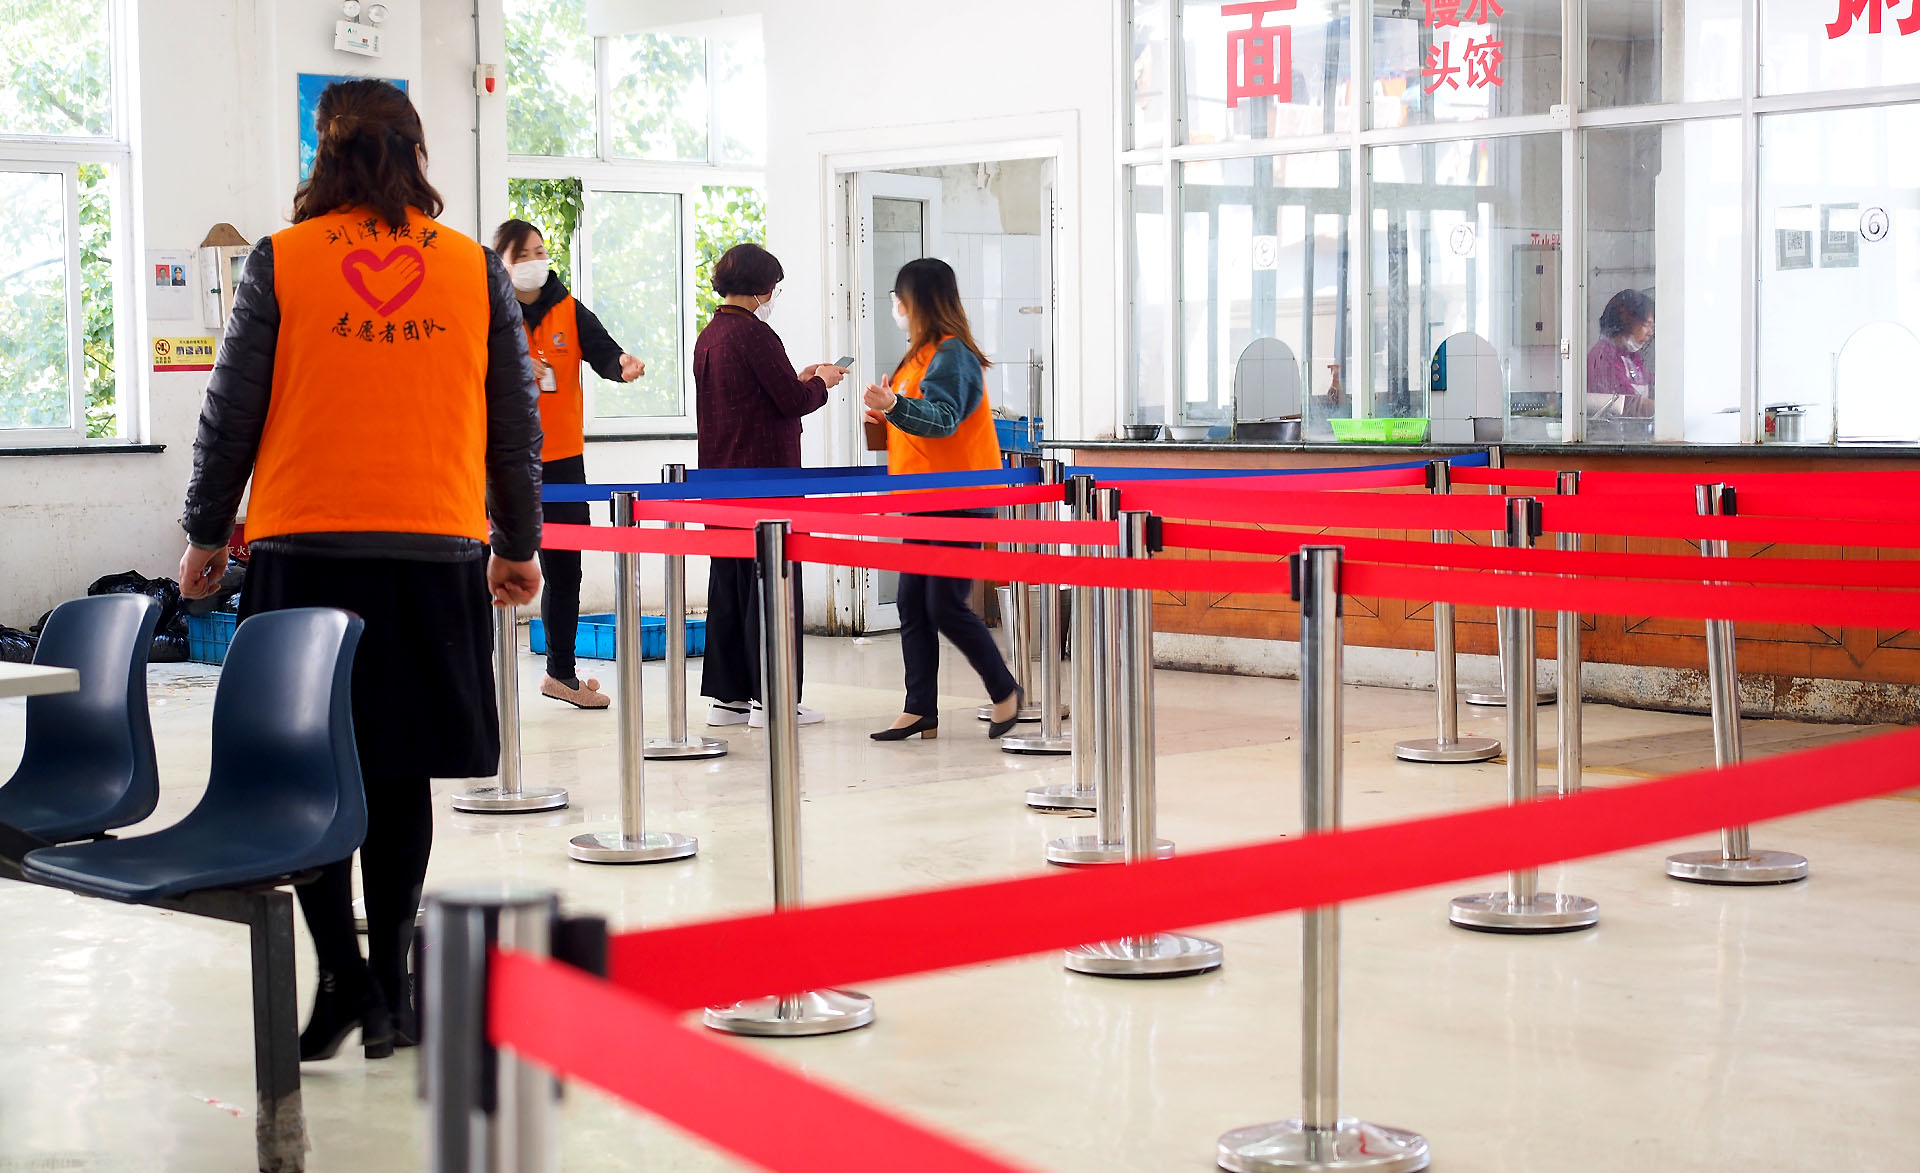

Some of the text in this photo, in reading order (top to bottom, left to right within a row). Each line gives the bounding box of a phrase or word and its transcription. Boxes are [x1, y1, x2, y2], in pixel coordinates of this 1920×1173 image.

[1221, 0, 1297, 108] 面
[326, 218, 438, 249] 刘潭服装
[332, 312, 446, 343] 志愿者团队
